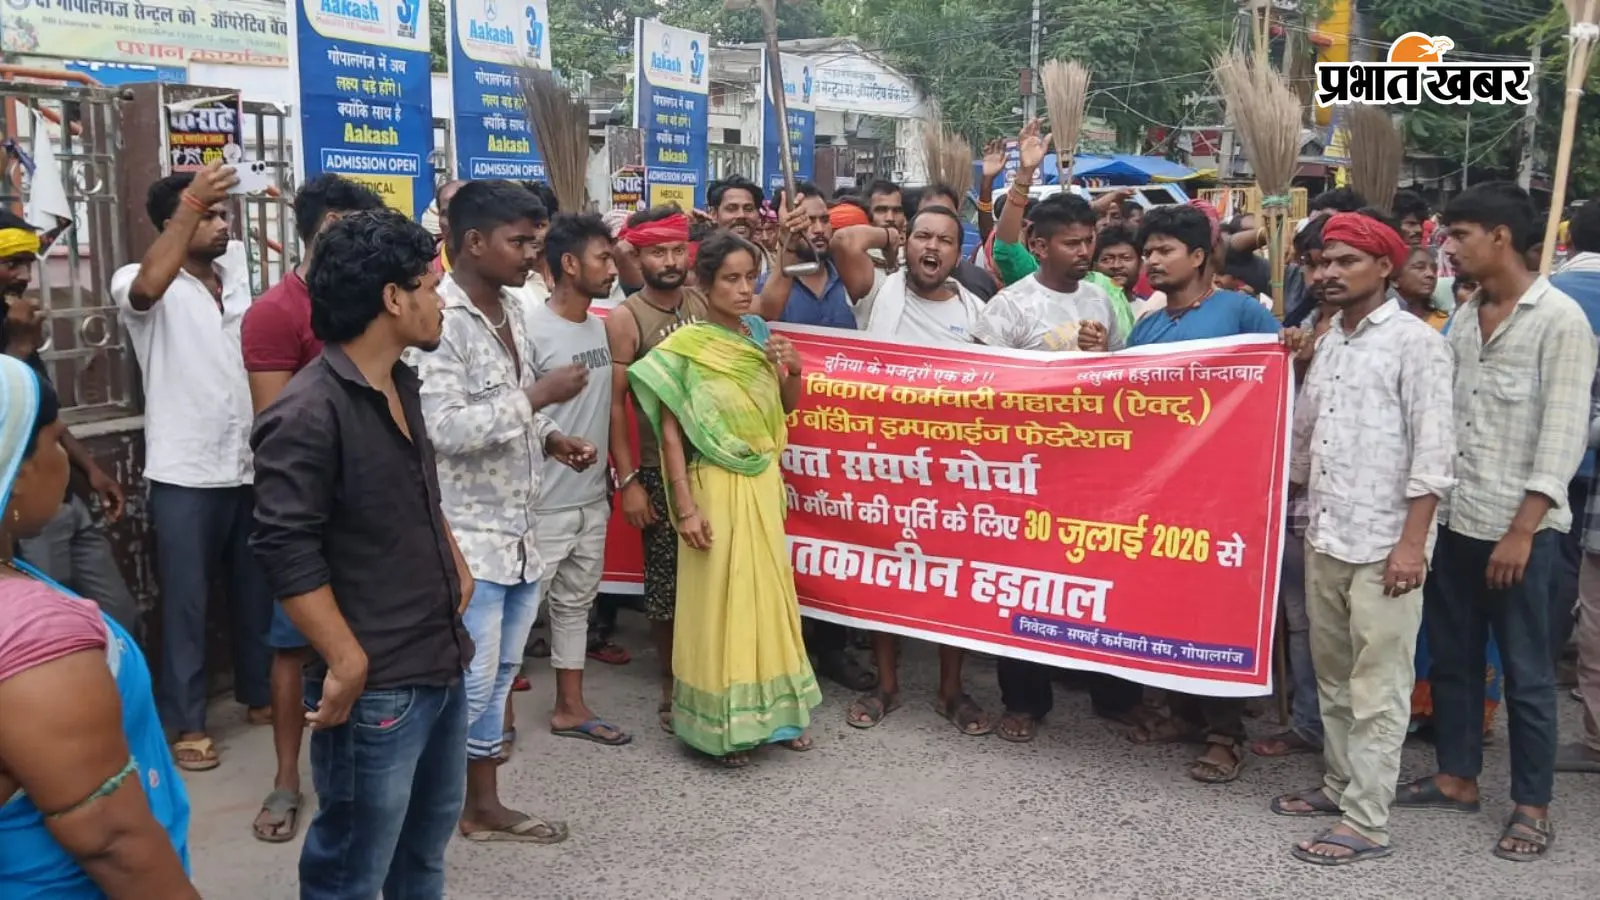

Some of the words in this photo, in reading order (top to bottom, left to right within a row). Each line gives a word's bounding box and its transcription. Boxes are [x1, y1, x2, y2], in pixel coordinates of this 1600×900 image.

[133, 3, 173, 26] सेन्ट्रल
[177, 6, 196, 26] को
[210, 9, 266, 34] ऑपरेटिव
[470, 17, 514, 44] Aakash
[327, 45, 375, 70] गोपालगंज
[378, 53, 387, 72] में
[390, 59, 407, 75] अब
[651, 51, 682, 73] Aakash
[336, 76, 359, 92] लक्ष्य
[337, 98, 369, 119] क्योंकि
[372, 105, 392, 121] साथ
[394, 102, 402, 122] है
[344, 122, 399, 145] Aakash
[488, 134, 530, 153] Aakash
[326, 155, 387, 170] ADMISSION
[389, 158, 417, 172] OPEN
[474, 163, 520, 176] ADMISSION
[522, 164, 544, 176] OPEN
[648, 170, 680, 181] ADMISSION
[681, 172, 697, 182] OPEN
[824, 353, 864, 373] दुनिया
[867, 360, 881, 374] के
[886, 362, 931, 382] मजदूरों
[934, 369, 958, 383] एक
[961, 368, 978, 384] हो
[1128, 365, 1184, 385] हड़ताल
[1190, 361, 1266, 385] जिन्दाबाद
[805, 372, 889, 404] निकाय
[892, 384, 995, 409] कर्मचारी
[1000, 387, 1105, 414] महासंघ
[803, 404, 875, 435] बॉडीज
[879, 416, 1011, 446] इम्पलाईज
[1015, 420, 1133, 450] फेडरेशन
[781, 444, 831, 479] क्त
[838, 442, 933, 486] संघर्ष
[940, 449, 1041, 496] मोर्चा
[858, 494, 890, 525] की
[894, 498, 939, 539] पूर्ति
[942, 502, 968, 533] के
[973, 503, 1020, 540] लिए
[1024, 509, 1051, 542] 30
[1056, 514, 1149, 564] जुलाई
[1151, 524, 1210, 563] 2026
[1216, 532, 1246, 568] से
[785, 534, 963, 599] तकालीन
[970, 559, 1113, 623] हड़ताल
[1067, 626, 1098, 648] सफाई
[1101, 630, 1148, 653] कर्मचारी
[1181, 641, 1244, 665] गोपालगंज
